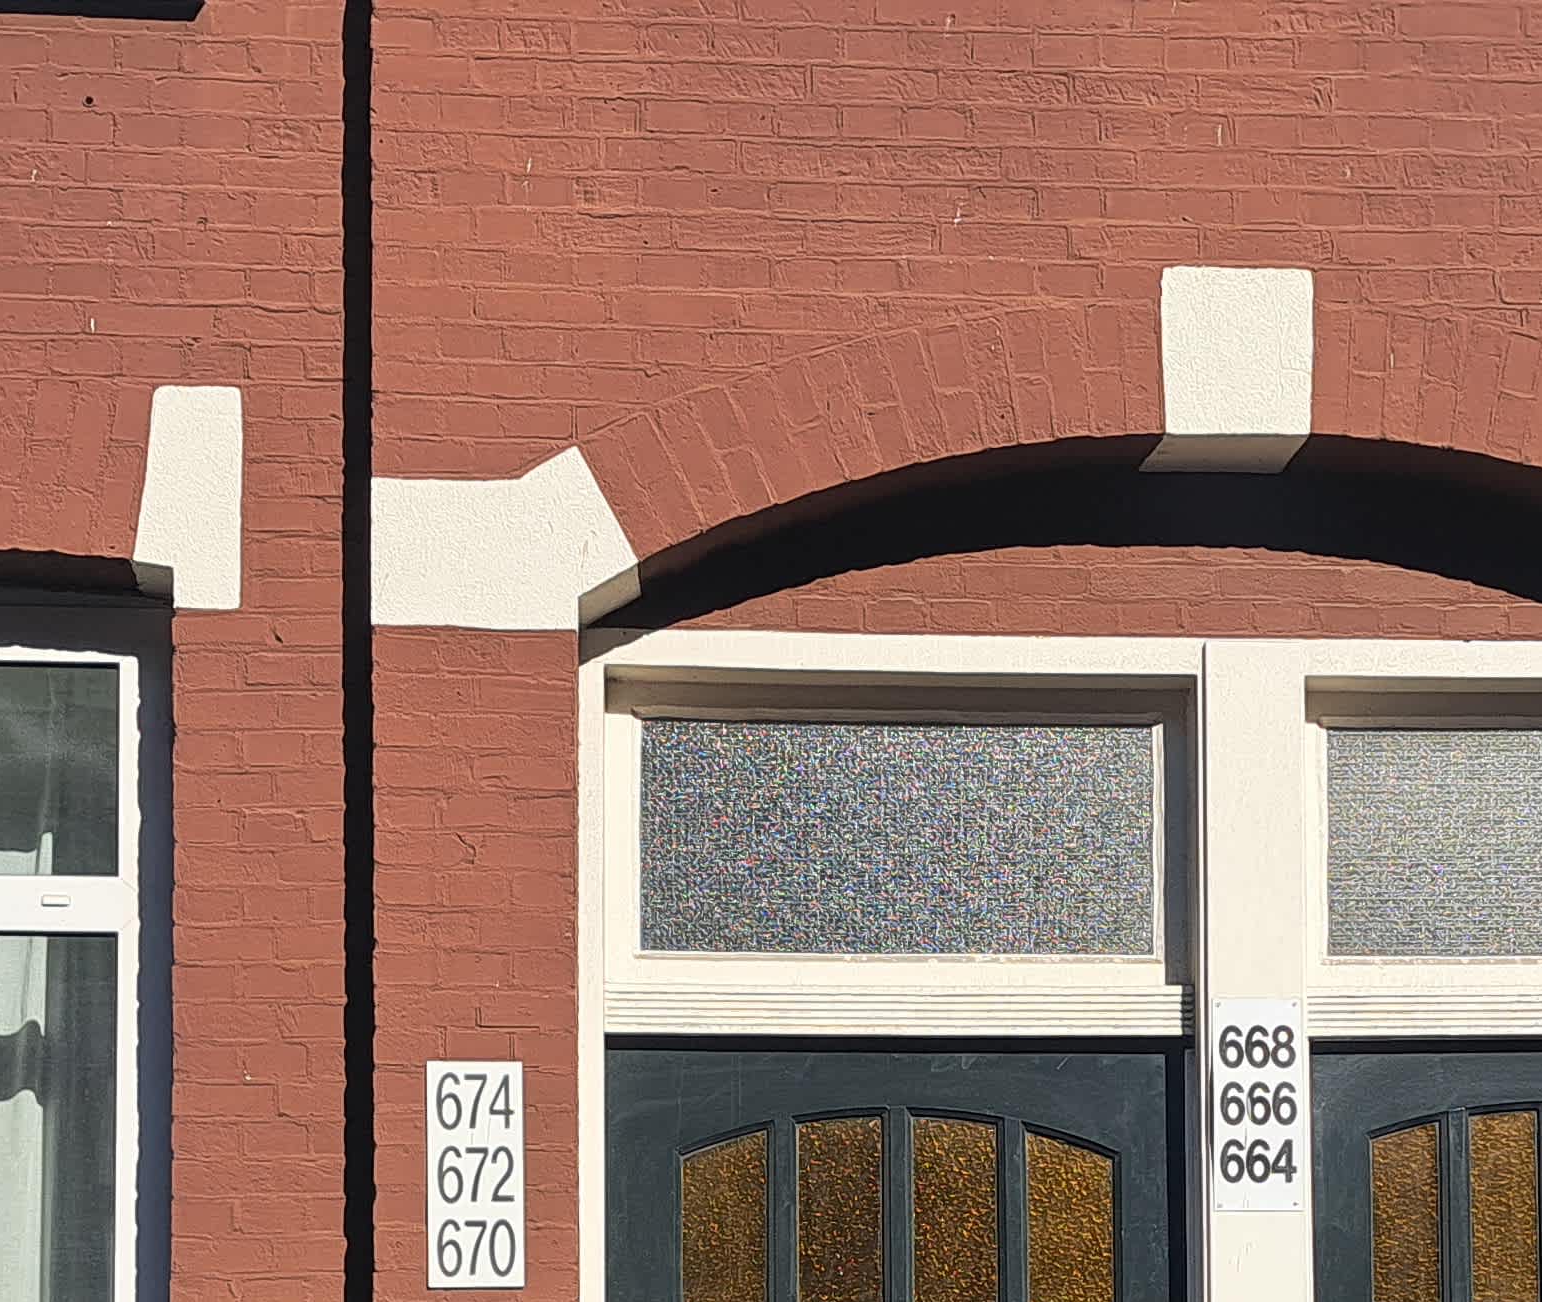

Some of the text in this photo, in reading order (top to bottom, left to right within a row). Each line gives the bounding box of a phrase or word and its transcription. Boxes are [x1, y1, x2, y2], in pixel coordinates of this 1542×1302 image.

[1219, 1024, 1296, 1069] 668
[436, 1072, 515, 1130] 674
[1220, 1081, 1297, 1126] 666
[437, 1146, 515, 1204] 672
[1220, 1138, 1297, 1183] 664
[437, 1219, 515, 1277] 670
